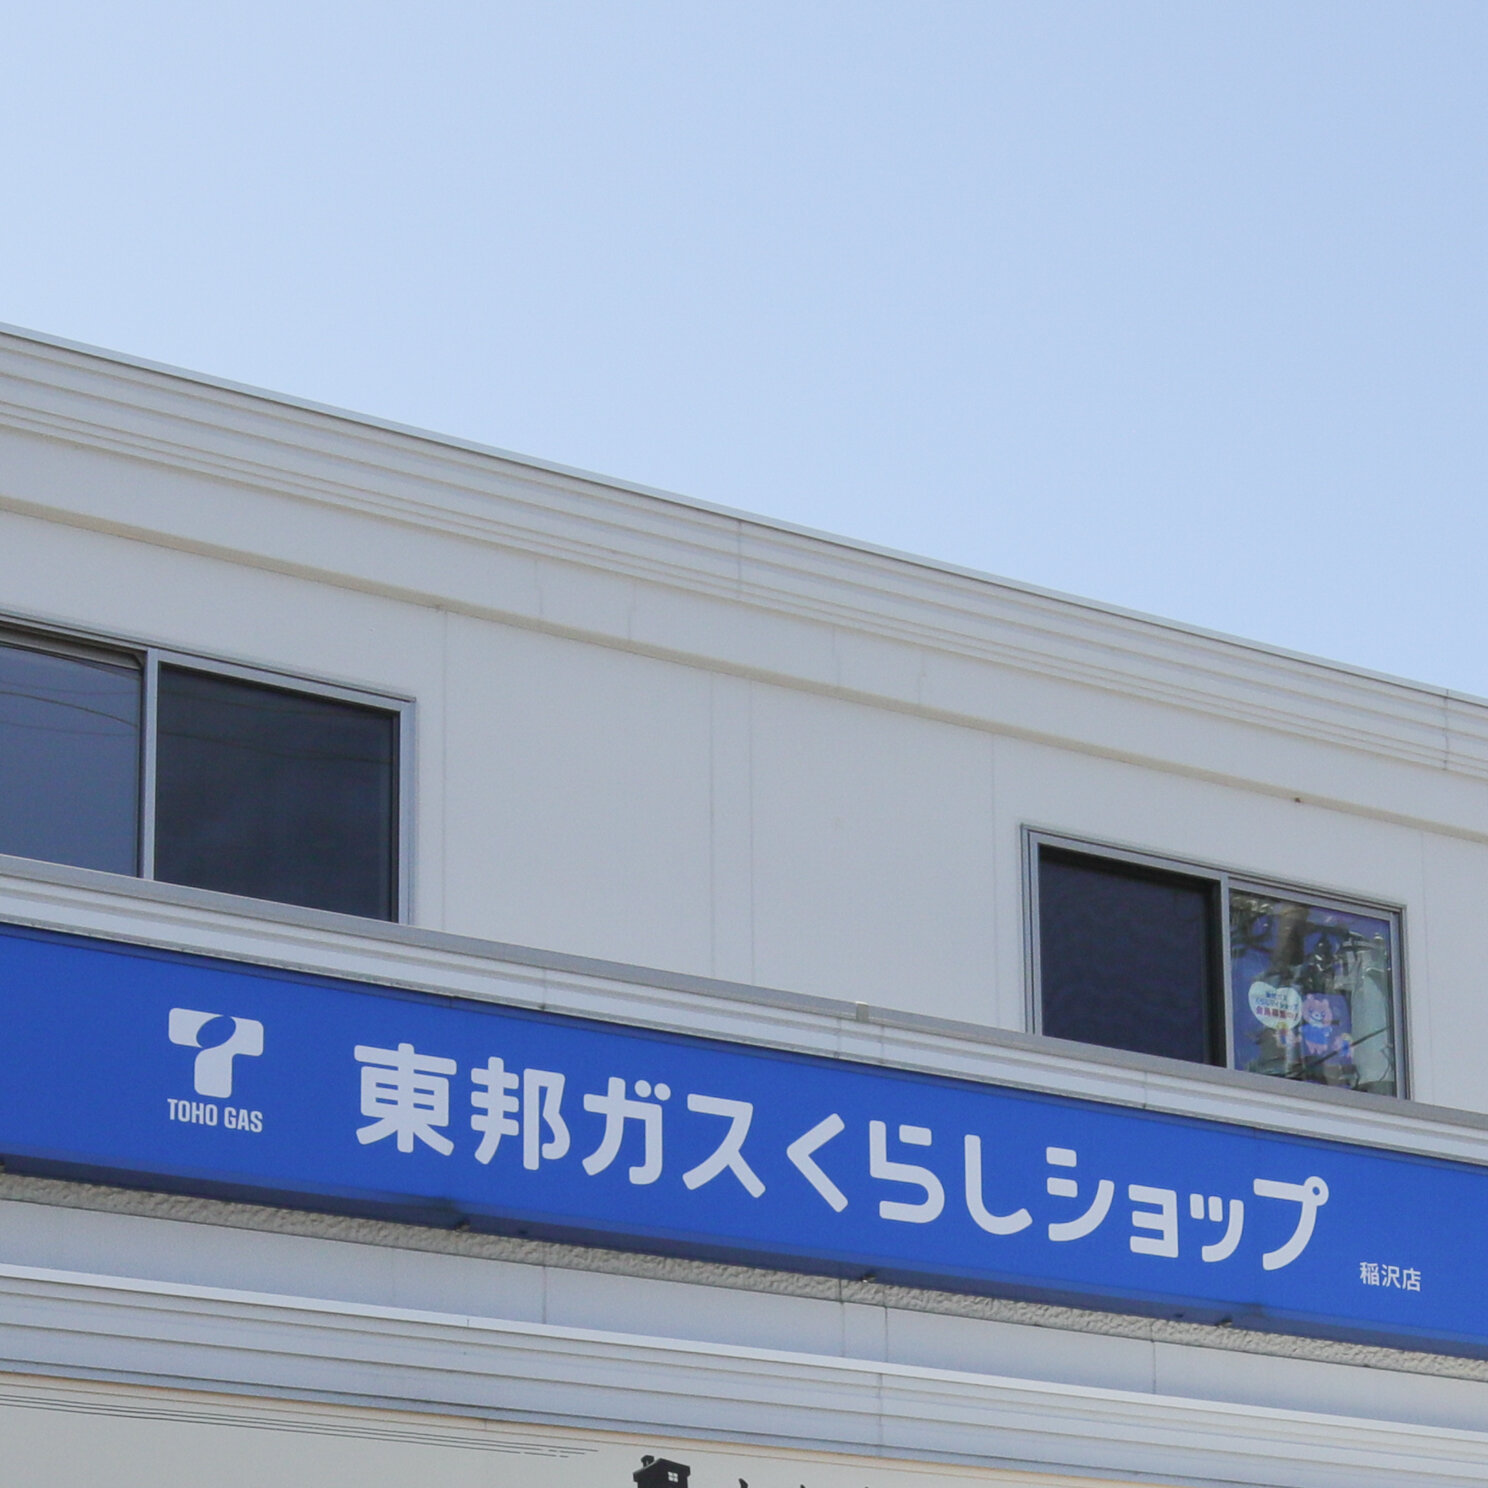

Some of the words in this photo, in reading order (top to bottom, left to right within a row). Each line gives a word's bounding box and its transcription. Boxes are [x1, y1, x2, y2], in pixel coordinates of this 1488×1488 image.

[167, 1098, 218, 1126] TOHO
[224, 1106, 263, 1132] GAS
[353, 1042, 1329, 1271] 東邦ガスくらしショップ
[1359, 1260, 1421, 1293] 稲沢店
